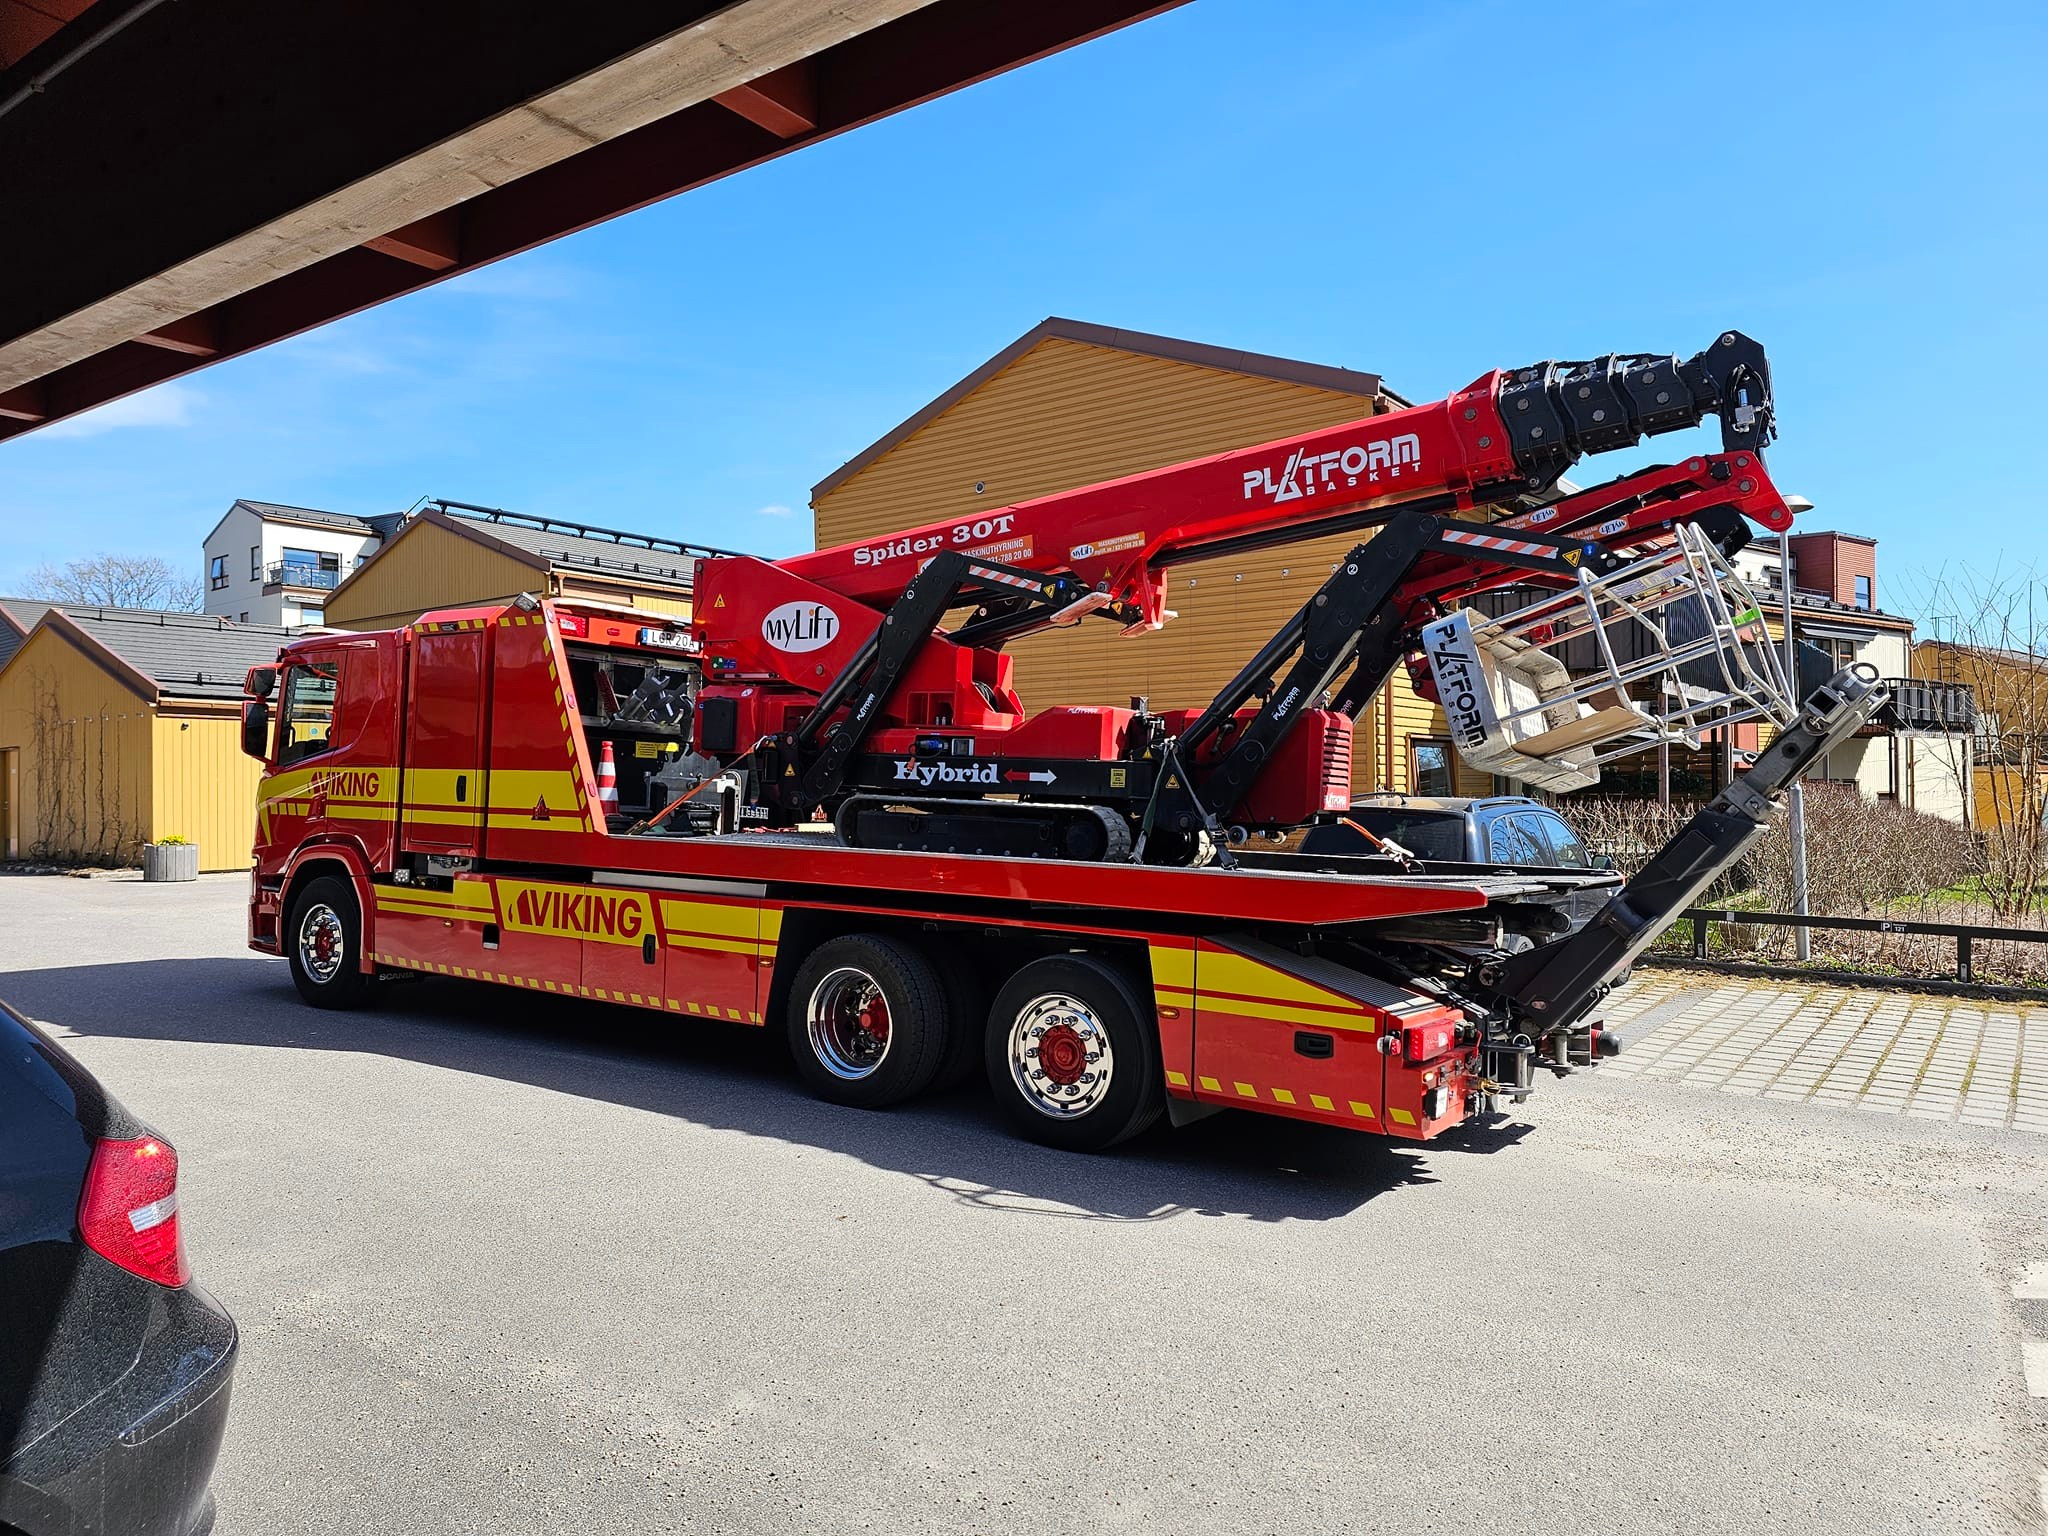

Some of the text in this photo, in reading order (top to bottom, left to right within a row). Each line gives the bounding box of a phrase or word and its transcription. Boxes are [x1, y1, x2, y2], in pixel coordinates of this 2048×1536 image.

[1243, 433, 1421, 503] PLATFORM
[1306, 462, 1422, 496] BASKET
[854, 514, 1015, 567] Spider 30T
[1434, 623, 1489, 749] PLATFORM
[1440, 673, 1470, 750] BASKET
[318, 771, 380, 798] VIKING
[893, 761, 1001, 786] Hybrid
[529, 889, 642, 939] VIKING
